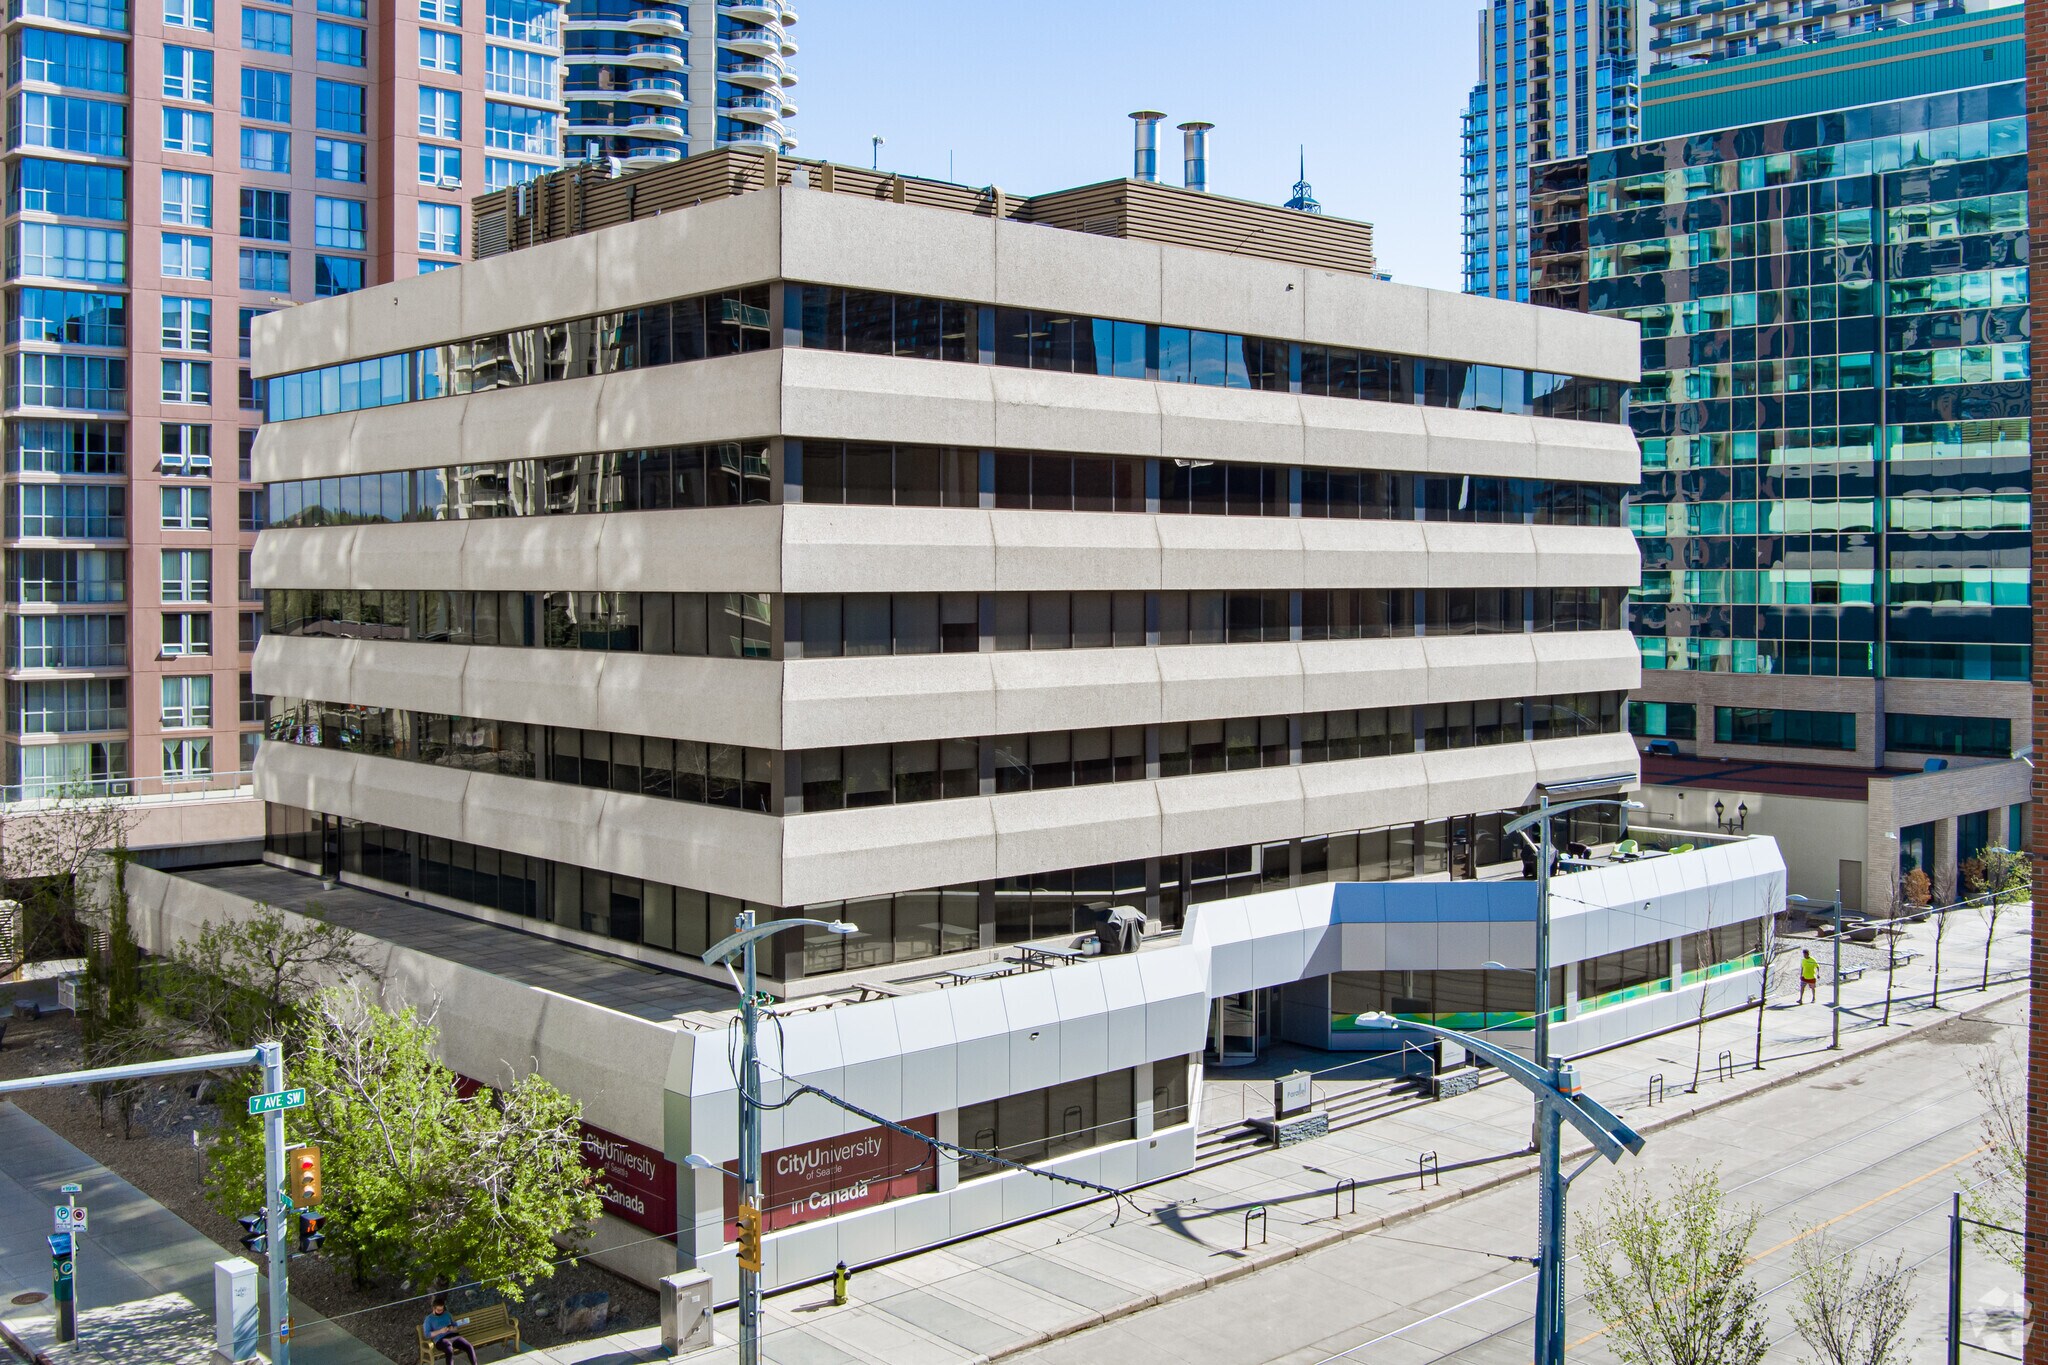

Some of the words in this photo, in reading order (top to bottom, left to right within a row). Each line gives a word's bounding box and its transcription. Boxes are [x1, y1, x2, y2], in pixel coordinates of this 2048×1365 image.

[254, 1098, 261, 1110] 7
[264, 1095, 283, 1109] AVE
[286, 1091, 301, 1105] SW
[586, 1132, 656, 1181] CityUniversity
[776, 1136, 882, 1175] CityUniversity
[806, 1170, 814, 1180] of
[605, 1183, 645, 1215] Canada
[791, 1197, 804, 1215] in
[808, 1182, 869, 1210] Canada
